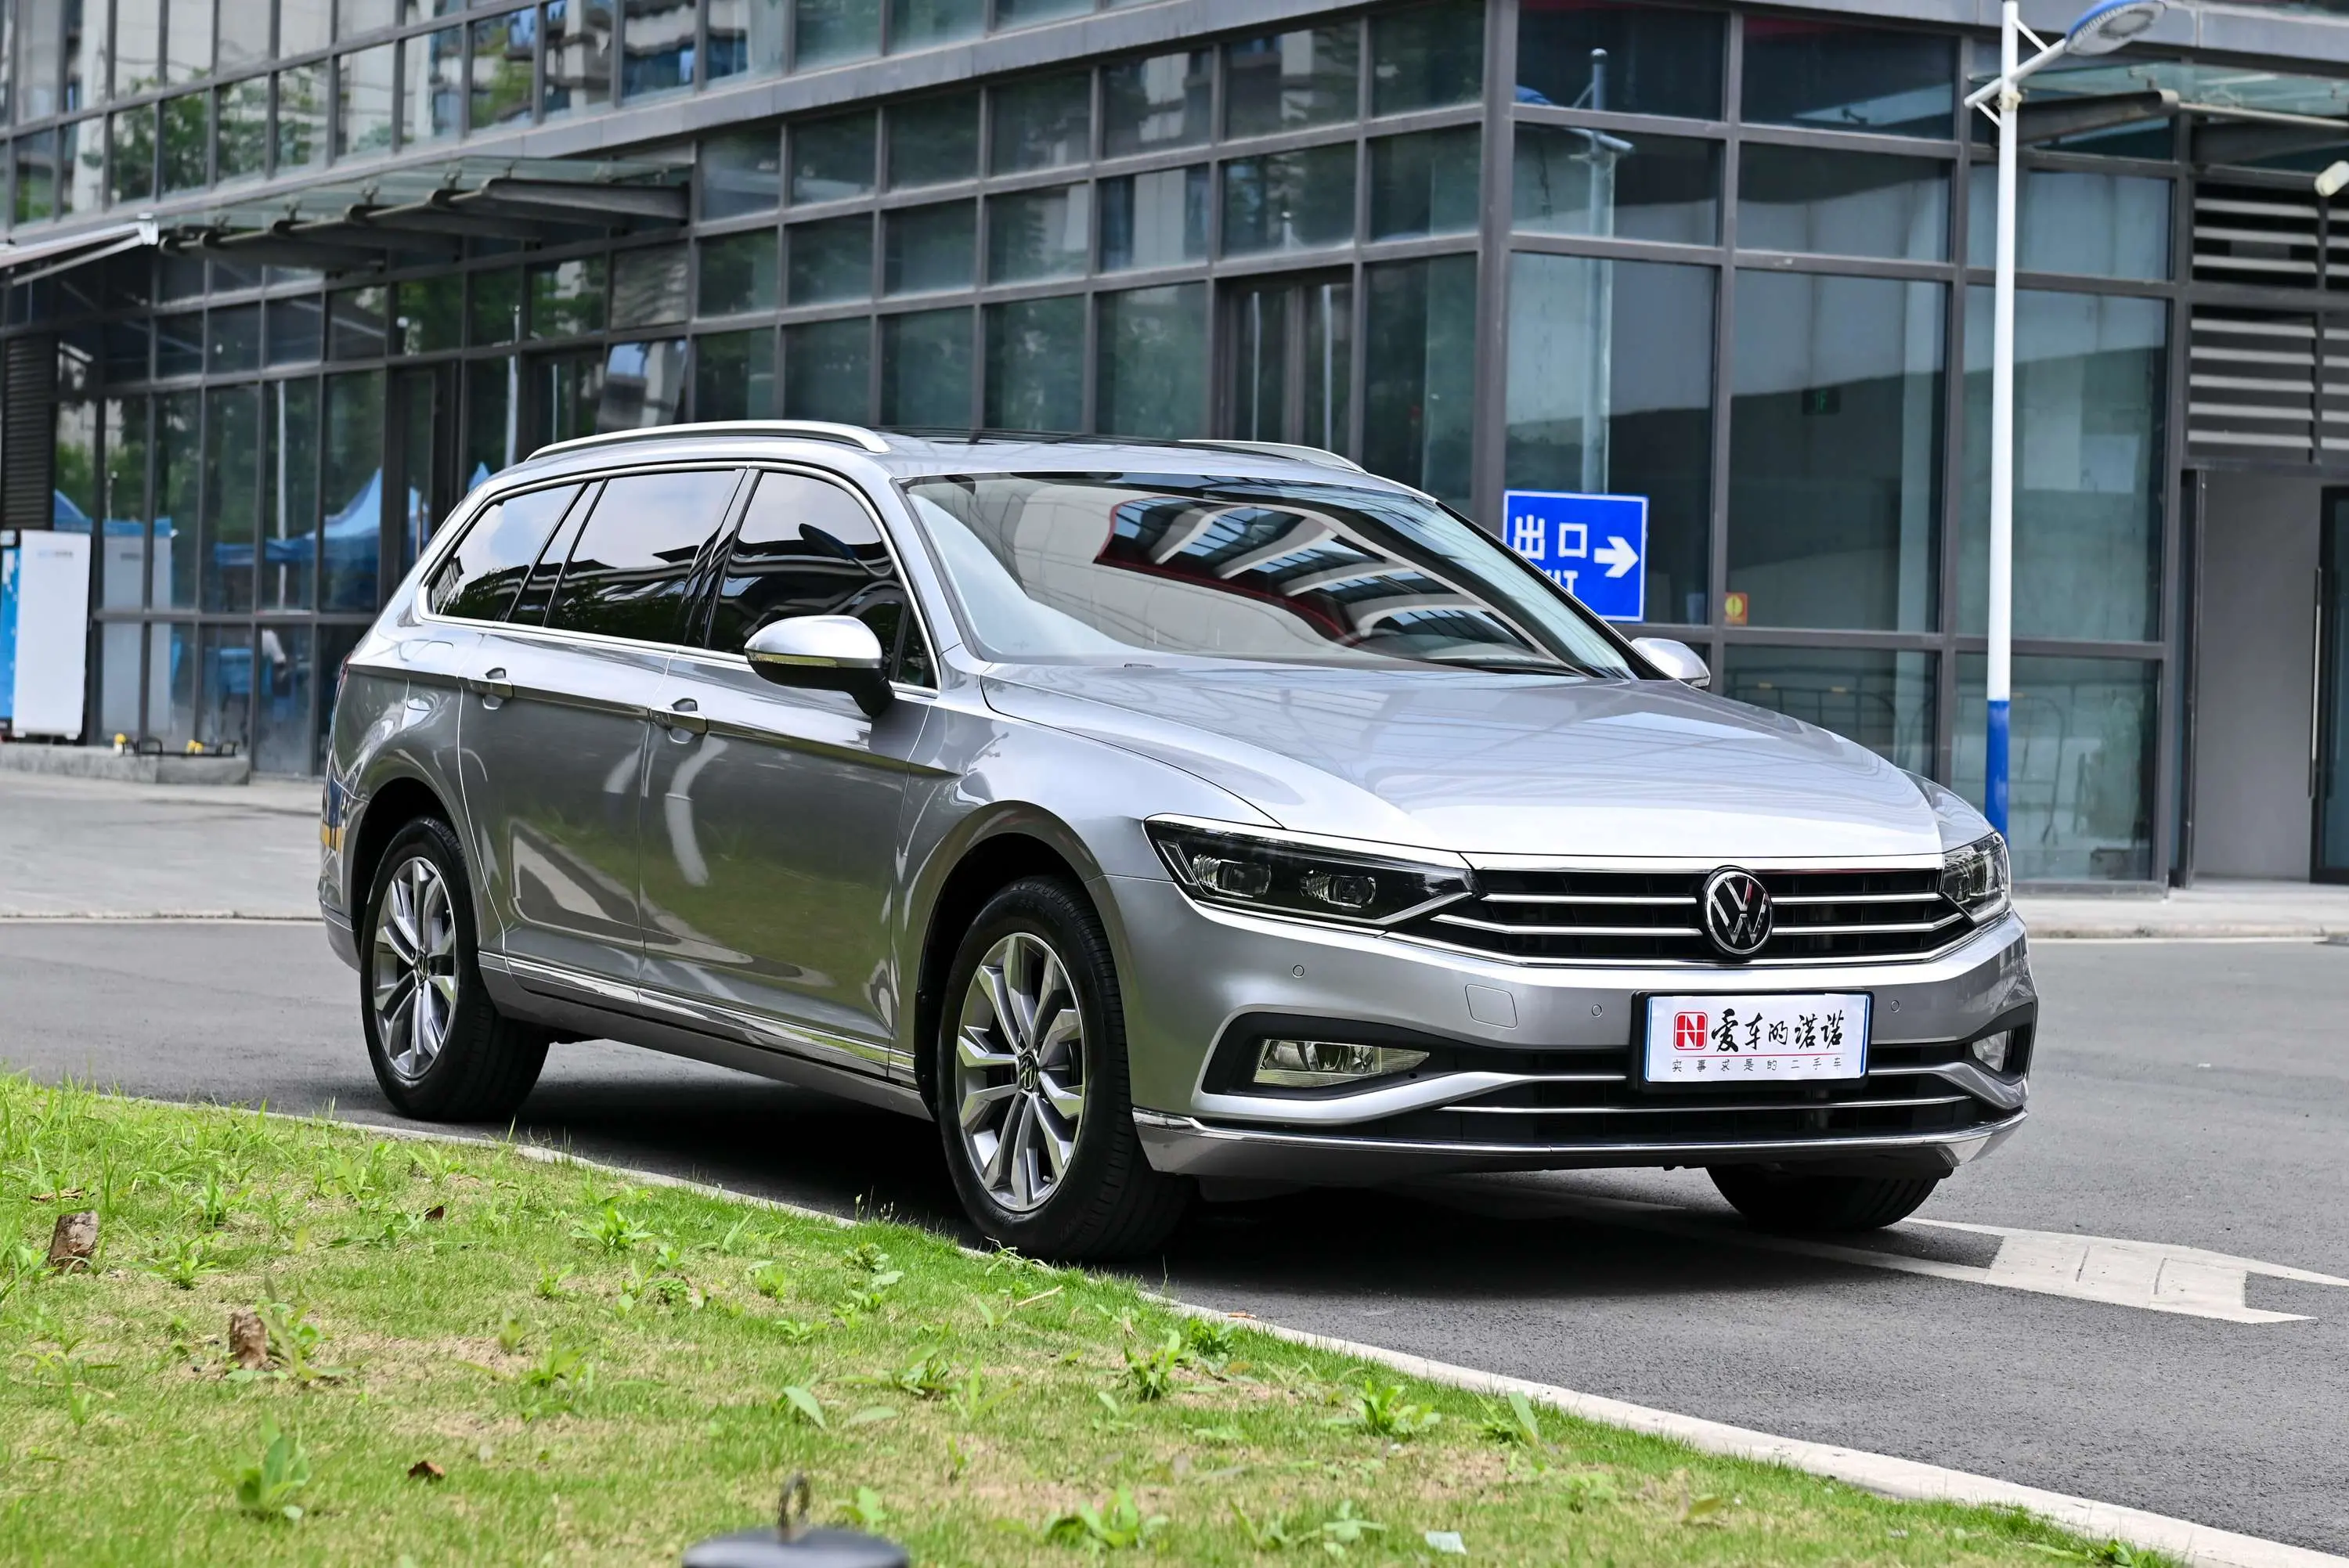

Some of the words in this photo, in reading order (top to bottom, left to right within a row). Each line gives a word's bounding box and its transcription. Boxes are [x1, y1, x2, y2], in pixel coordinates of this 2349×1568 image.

[1513, 514, 1589, 561] 出口
[1710, 874, 1768, 947] VW
[1672, 1057, 1842, 1072] 实事求是的二手车
